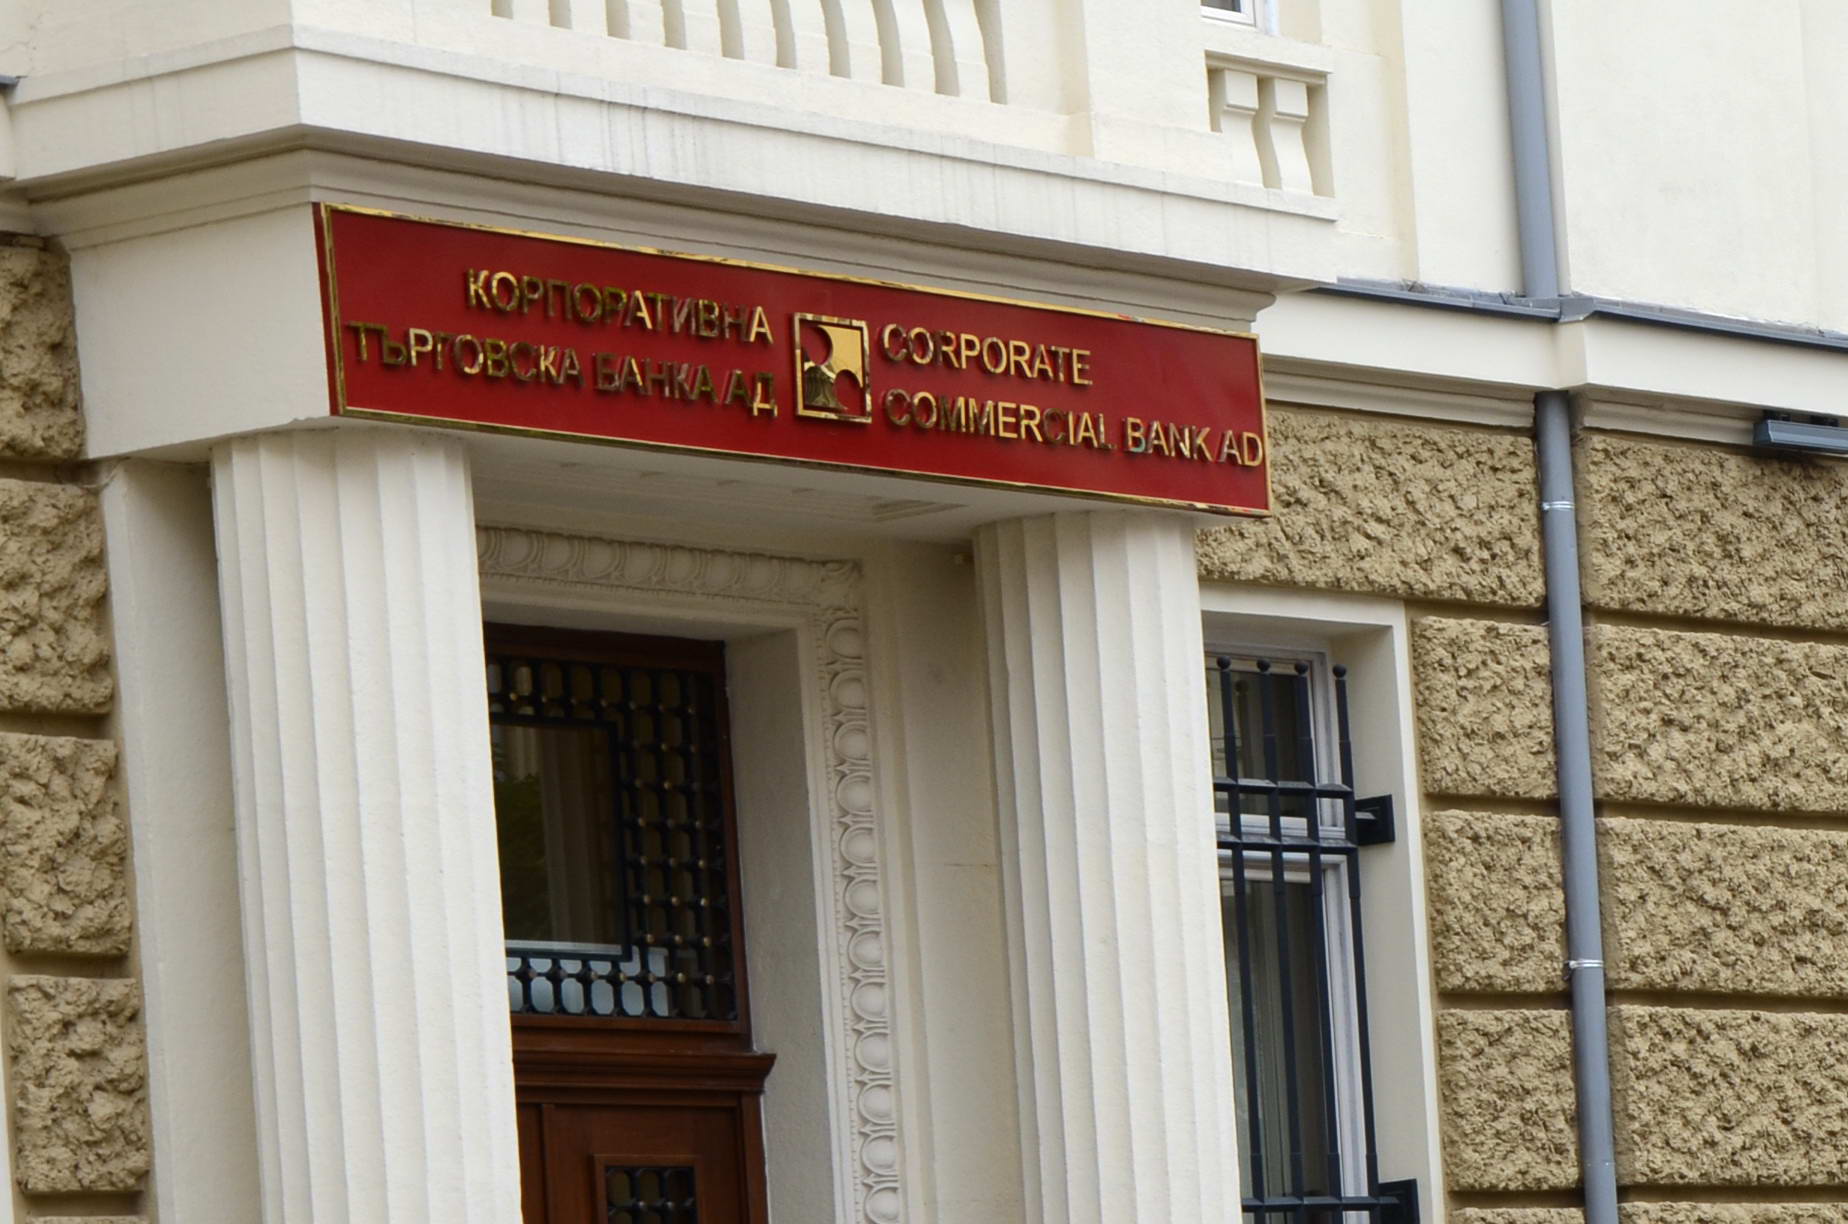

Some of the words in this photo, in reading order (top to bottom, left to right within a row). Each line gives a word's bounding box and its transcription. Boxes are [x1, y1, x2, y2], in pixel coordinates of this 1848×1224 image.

[465, 268, 774, 345] КОРПОРАТИВНА
[348, 321, 584, 387] ТЪРГОВСКА
[593, 352, 718, 404] БАНКА
[724, 369, 778, 418] АД
[882, 323, 1093, 386] CORPORATE
[884, 388, 1116, 451] COMMERCIAL
[1122, 417, 1215, 461] BANK
[1217, 430, 1263, 467] AD
